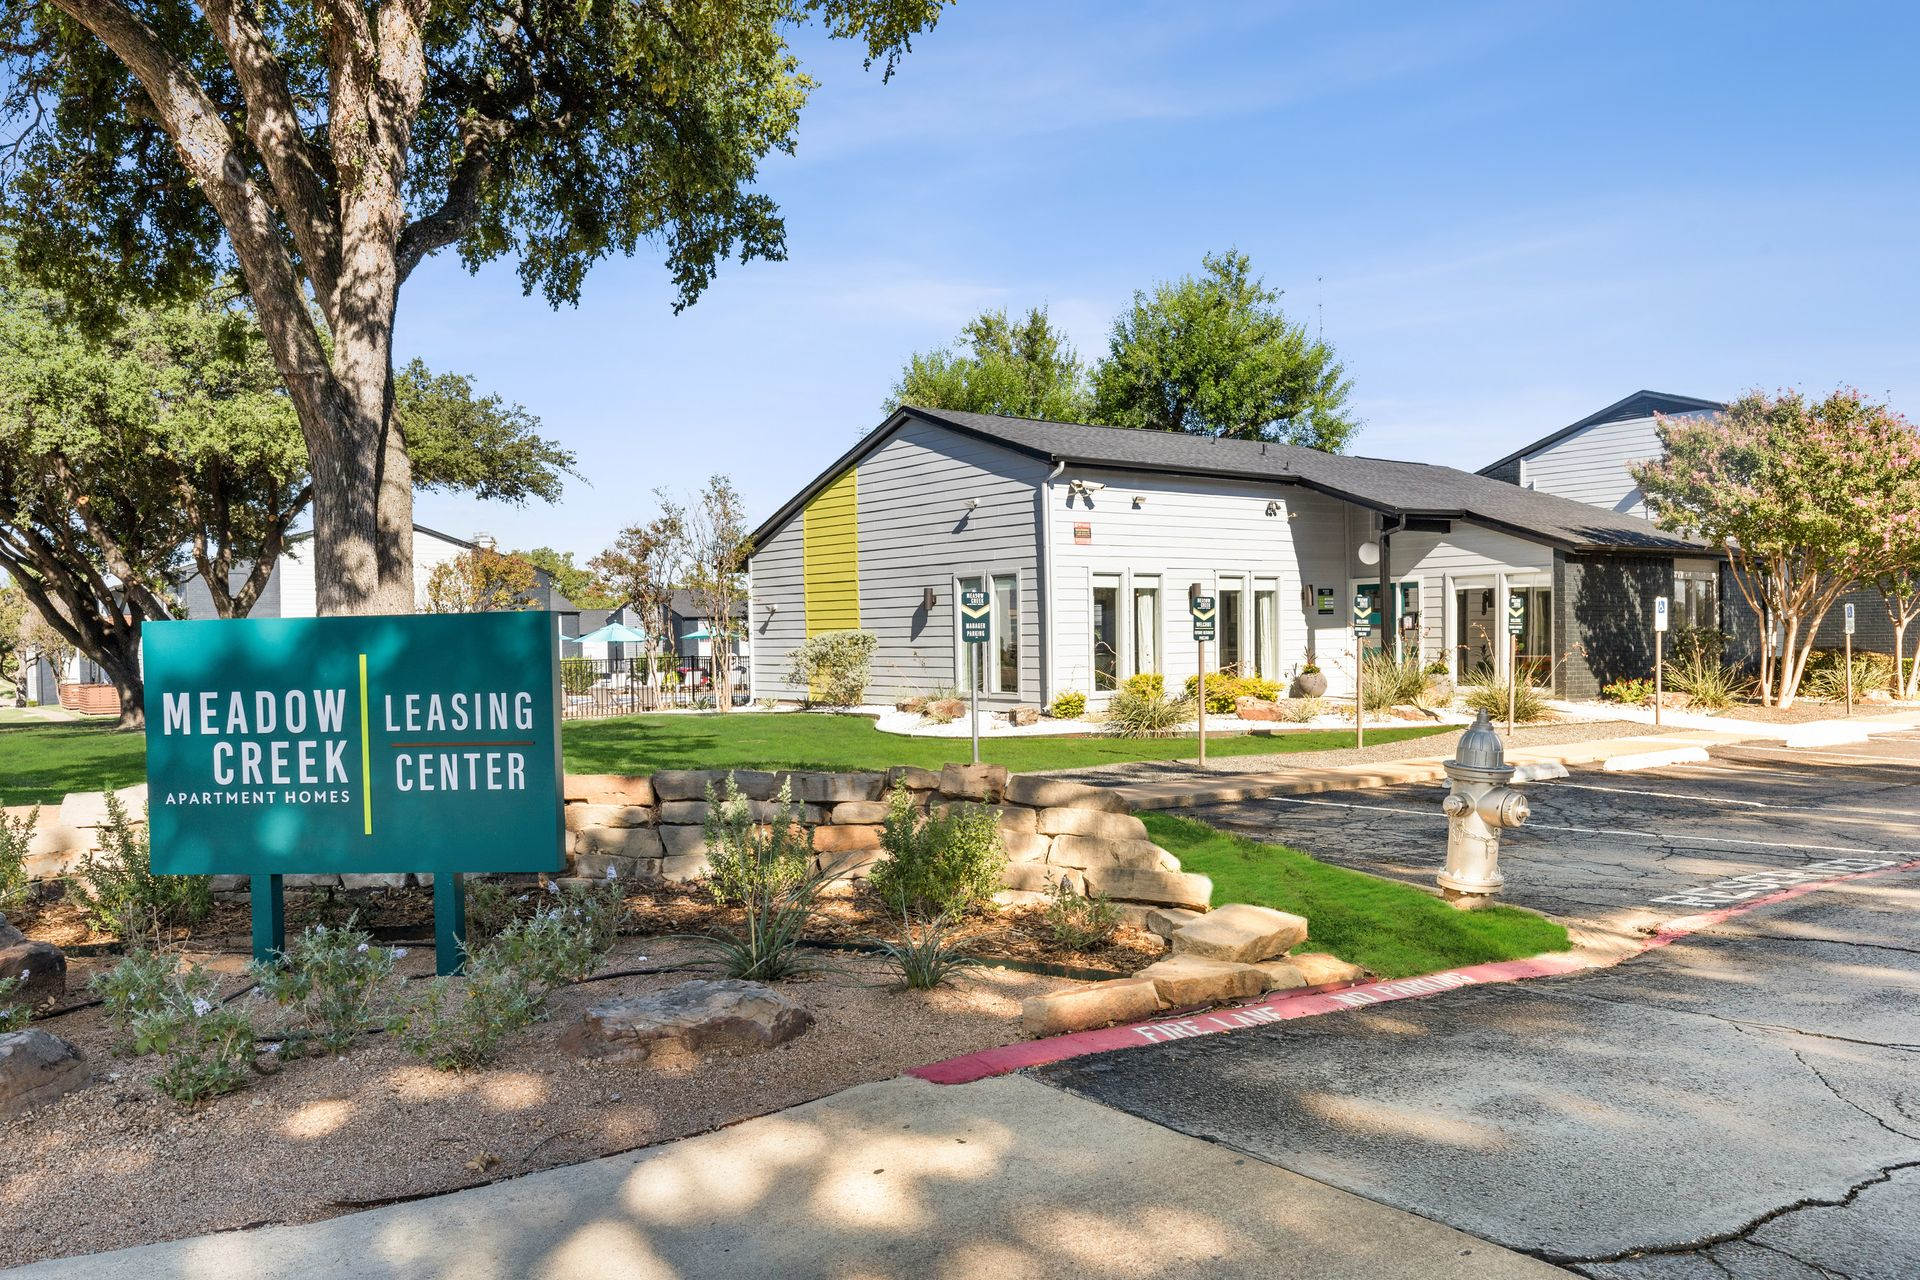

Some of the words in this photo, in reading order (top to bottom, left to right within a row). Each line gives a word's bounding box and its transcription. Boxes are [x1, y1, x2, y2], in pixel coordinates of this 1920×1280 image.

[162, 689, 346, 735] MEADOW
[385, 692, 533, 732] LEASING
[213, 740, 349, 785] CREEK
[396, 753, 525, 792] CENTER
[165, 791, 276, 805] APARTMENT
[285, 790, 350, 803] HOMES
[1330, 991, 1378, 1006] NO
[1372, 972, 1477, 997] PARKING
[1131, 1020, 1213, 1043] FIRE
[1208, 1006, 1281, 1028] LANE
